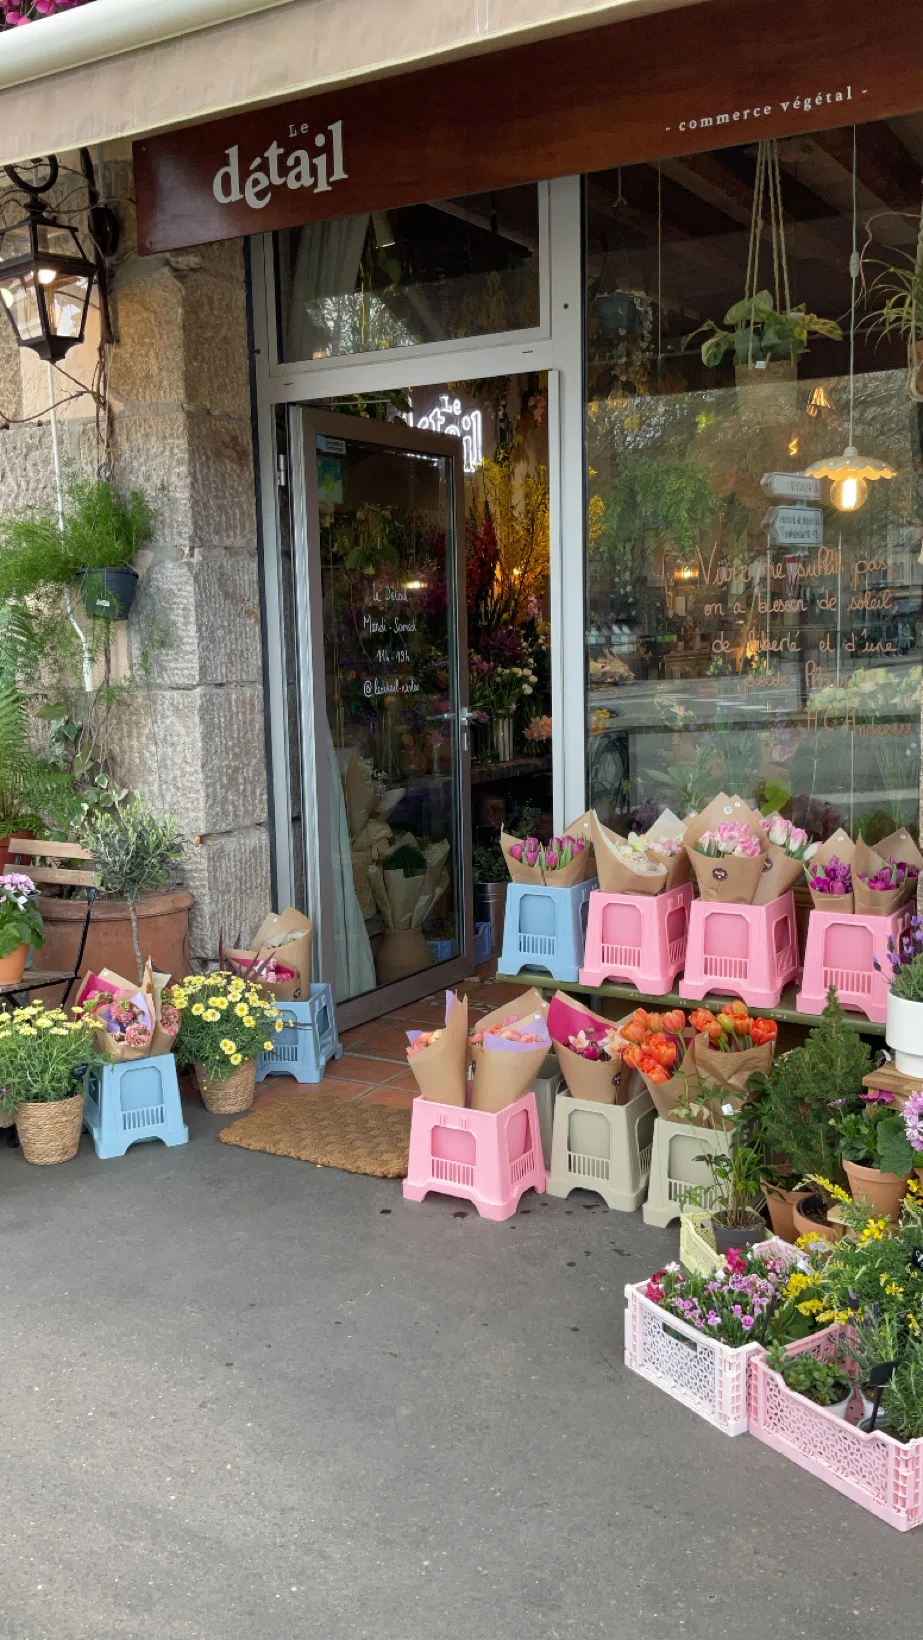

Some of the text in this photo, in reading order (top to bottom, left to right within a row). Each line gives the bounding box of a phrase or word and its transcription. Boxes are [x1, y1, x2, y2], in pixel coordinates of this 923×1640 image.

[678, 105, 772, 132] commerce
[780, 85, 853, 112] végétal
[288, 123, 309, 138] Le
[212, 119, 348, 209] détail
[439, 394, 462, 416] Le
[696, 542, 751, 586] Vivre
[764, 562, 786, 581] ne
[854, 560, 887, 591] pas
[703, 603, 725, 617] on
[758, 592, 809, 614] besoin
[817, 591, 838, 612] de
[363, 614, 387, 634] Mardi
[393, 616, 417, 634] Samedi
[712, 631, 734, 653] de
[819, 632, 836, 652] et
